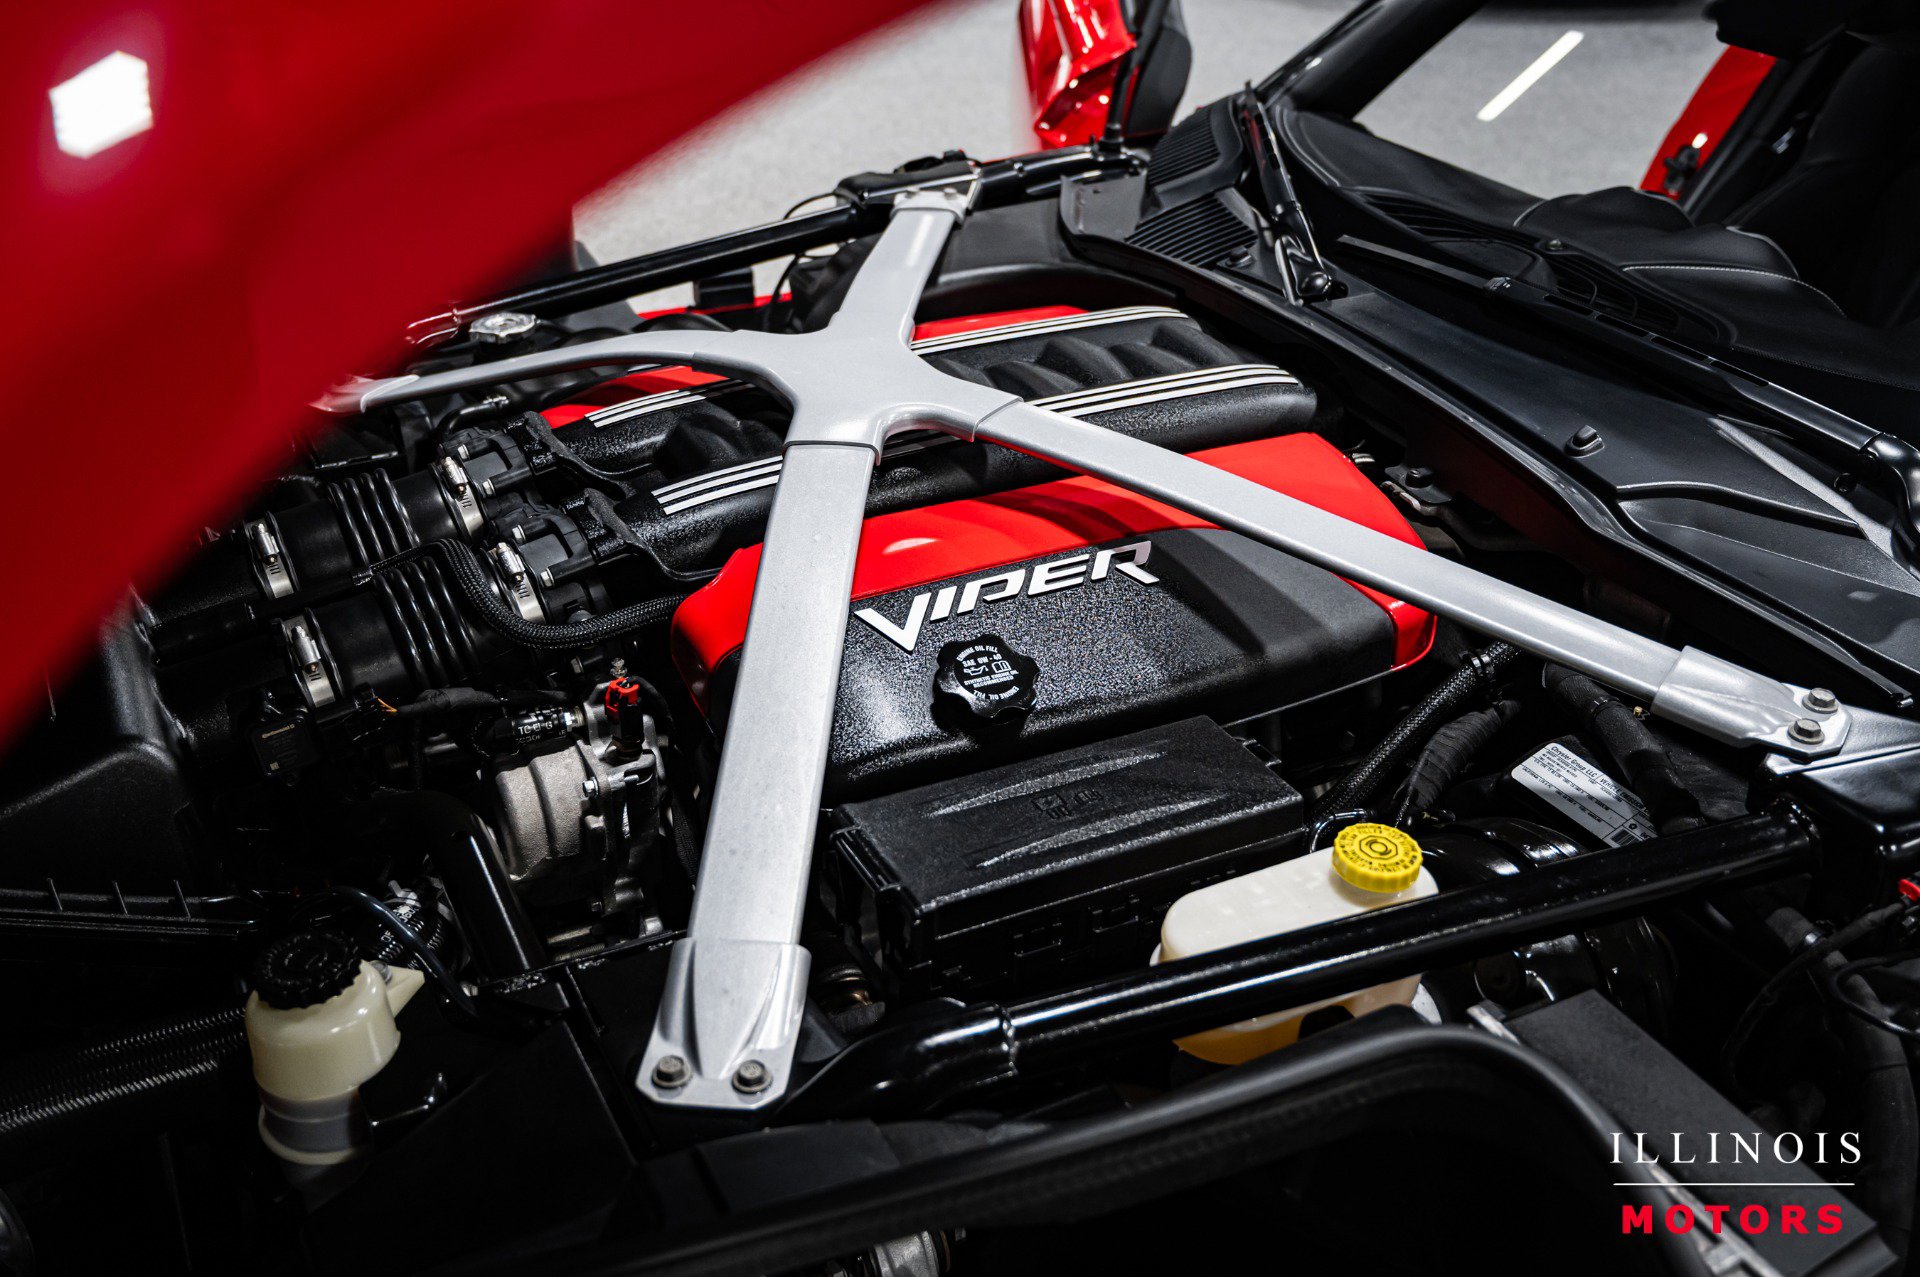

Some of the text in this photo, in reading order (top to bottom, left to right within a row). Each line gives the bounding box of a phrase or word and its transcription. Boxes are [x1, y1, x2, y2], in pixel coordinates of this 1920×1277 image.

[854, 541, 1159, 651] VIPER
[956, 646, 974, 661] ENGINE
[985, 645, 998, 653] FILL
[962, 658, 976, 667] SAE
[973, 689, 985, 699] FILL
[1000, 685, 1019, 699] ENGINE
[1551, 746, 1571, 760] Chrysler
[1571, 758, 1586, 771] Group
[1586, 769, 1597, 777] LLC
